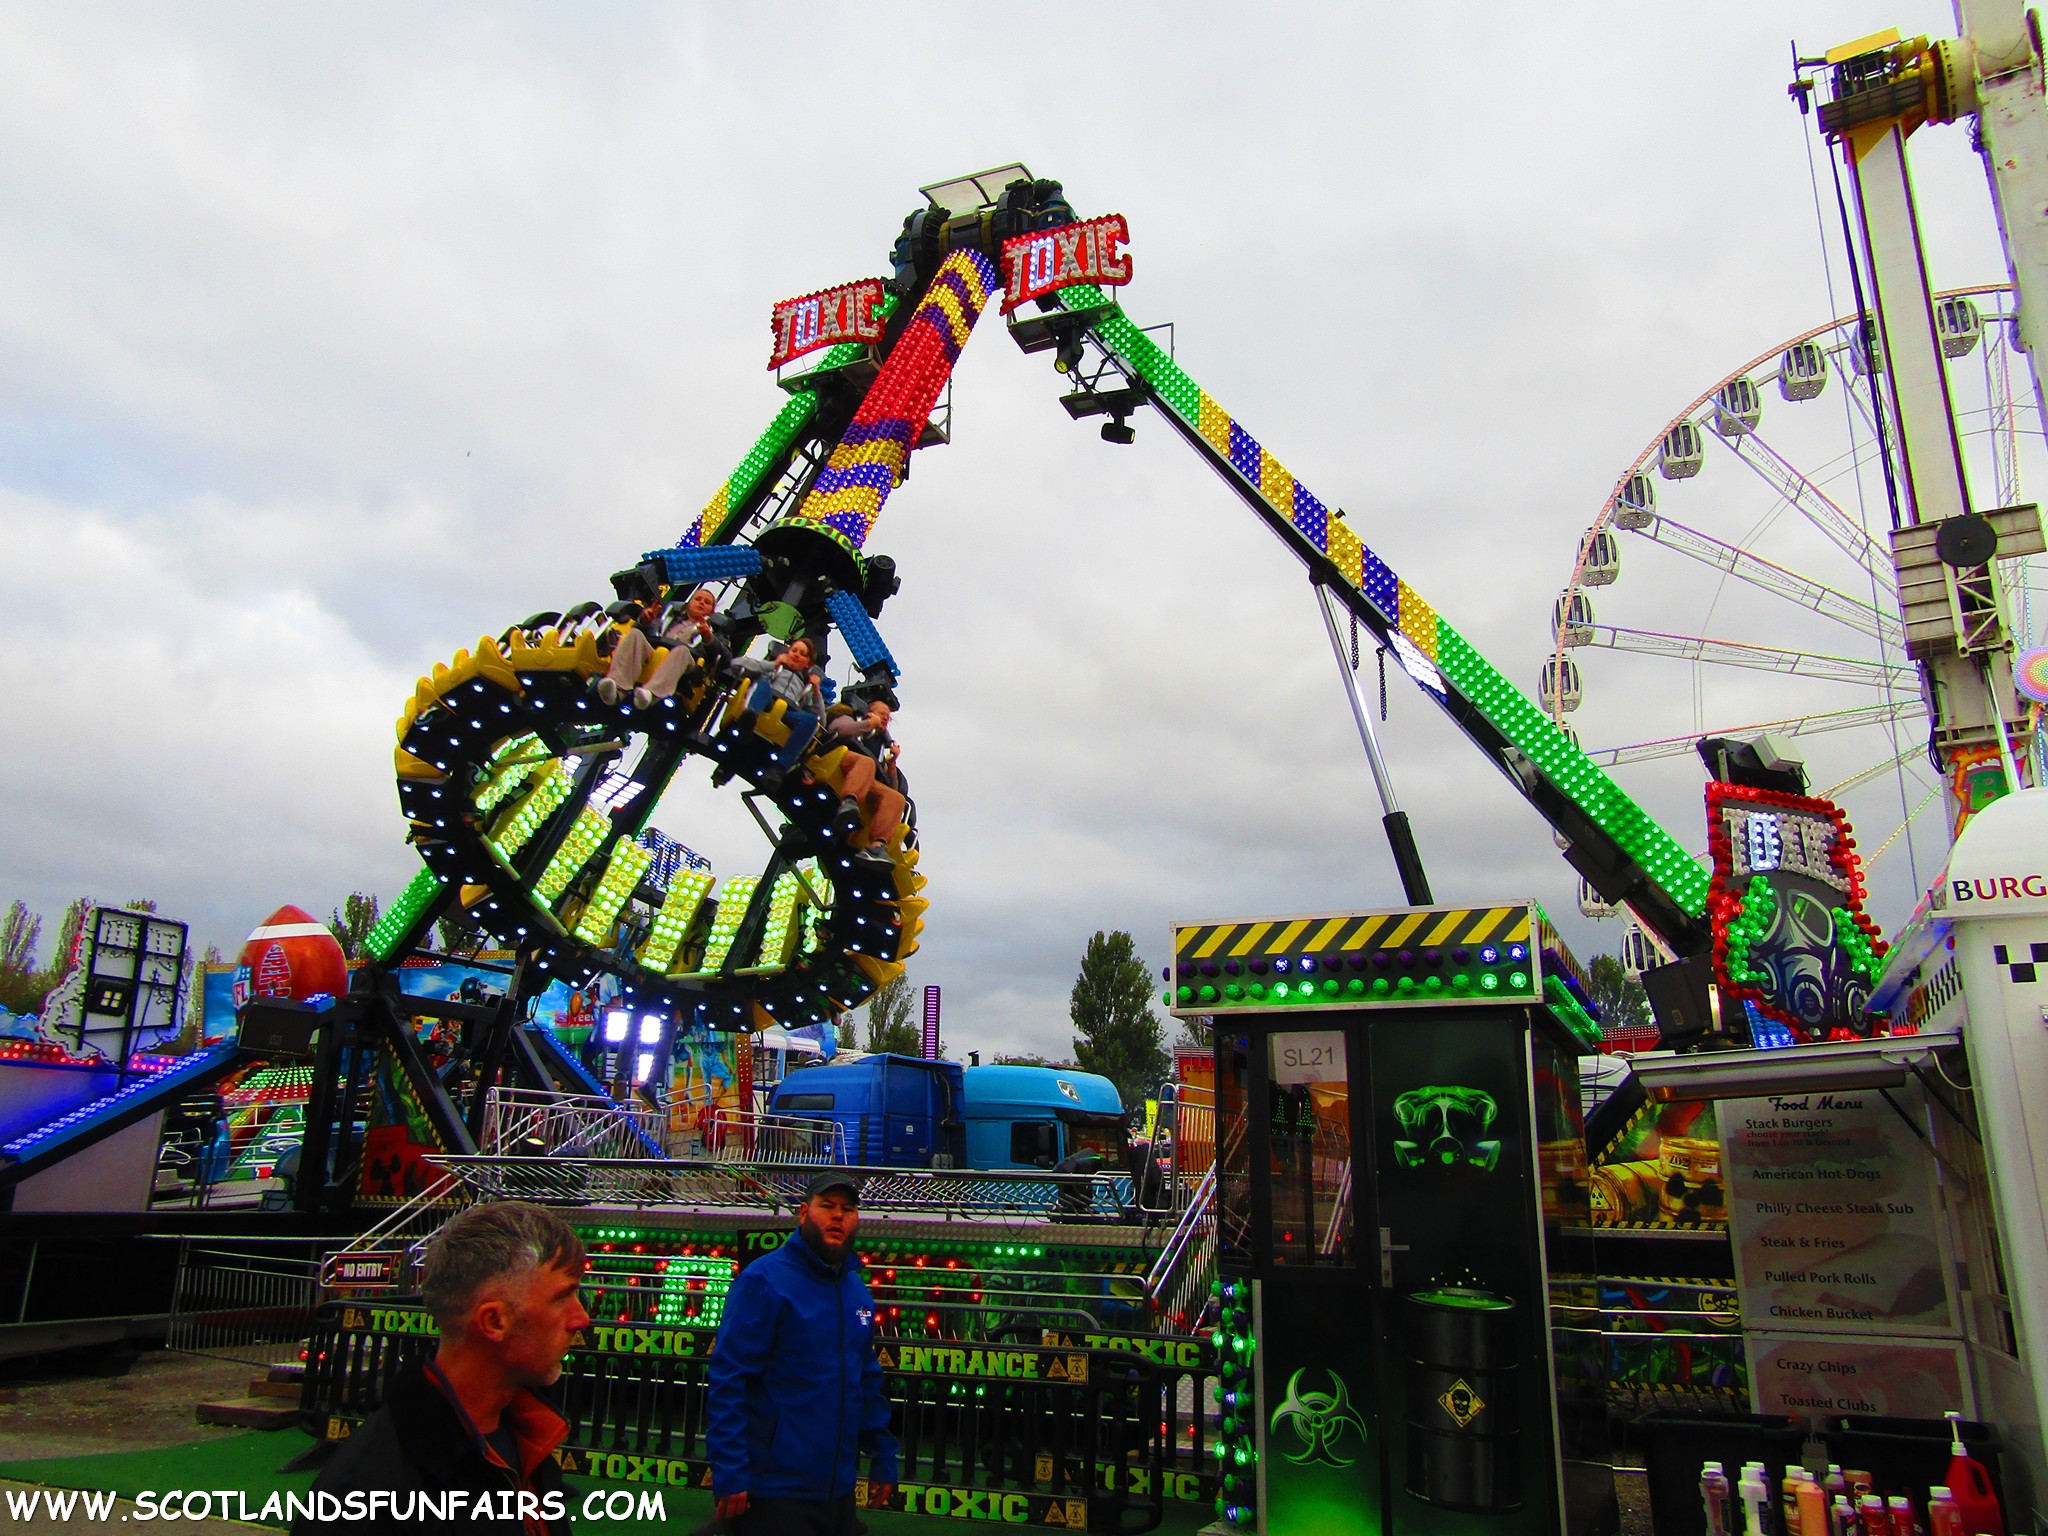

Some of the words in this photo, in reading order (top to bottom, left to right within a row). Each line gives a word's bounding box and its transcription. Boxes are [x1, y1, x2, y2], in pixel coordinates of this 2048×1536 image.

[1004, 219, 1128, 302] TOXIC
[774, 283, 881, 358] TOXIC
[1722, 806, 1853, 894] TOXIC
[1952, 874, 2047, 902] BURG
[1283, 1046, 1334, 1067] SL21
[1768, 1095, 1809, 1112] Food
[1816, 1095, 1863, 1111] Menu
[1746, 1118, 1779, 1129] Stack
[1783, 1118, 1833, 1130] Burgers
[1752, 1169, 1813, 1180] American
[1817, 1168, 1881, 1181] Hot-Dogs
[1757, 1202, 1792, 1217] Philly
[1796, 1203, 1843, 1215] Cheese
[1847, 1202, 1884, 1214] Steak
[1888, 1203, 1914, 1214] Sub
[1761, 1236, 1796, 1248] Steak
[1800, 1237, 1810, 1248] &
[1814, 1237, 1845, 1249] Fries
[343, 1263, 355, 1277] NO
[356, 1263, 383, 1277] ENTRY
[1765, 1270, 1806, 1283] Pulled
[1810, 1271, 1840, 1284] Pork
[1845, 1272, 1876, 1285] Rolls
[371, 1309, 440, 1335] TOXIC
[1770, 1305, 1822, 1318] Chicken
[1827, 1307, 1873, 1320] Bucket
[593, 1326, 695, 1356] TOXIC
[898, 1346, 1040, 1378] ENTRANCE
[1777, 1358, 1813, 1373] Crazy
[1818, 1360, 1857, 1374] Chips
[1780, 1394, 1833, 1409] Toasted
[1837, 1398, 1877, 1412] Clubs
[585, 1452, 689, 1486] TOXIC
[898, 1484, 1029, 1524] TOXIC
